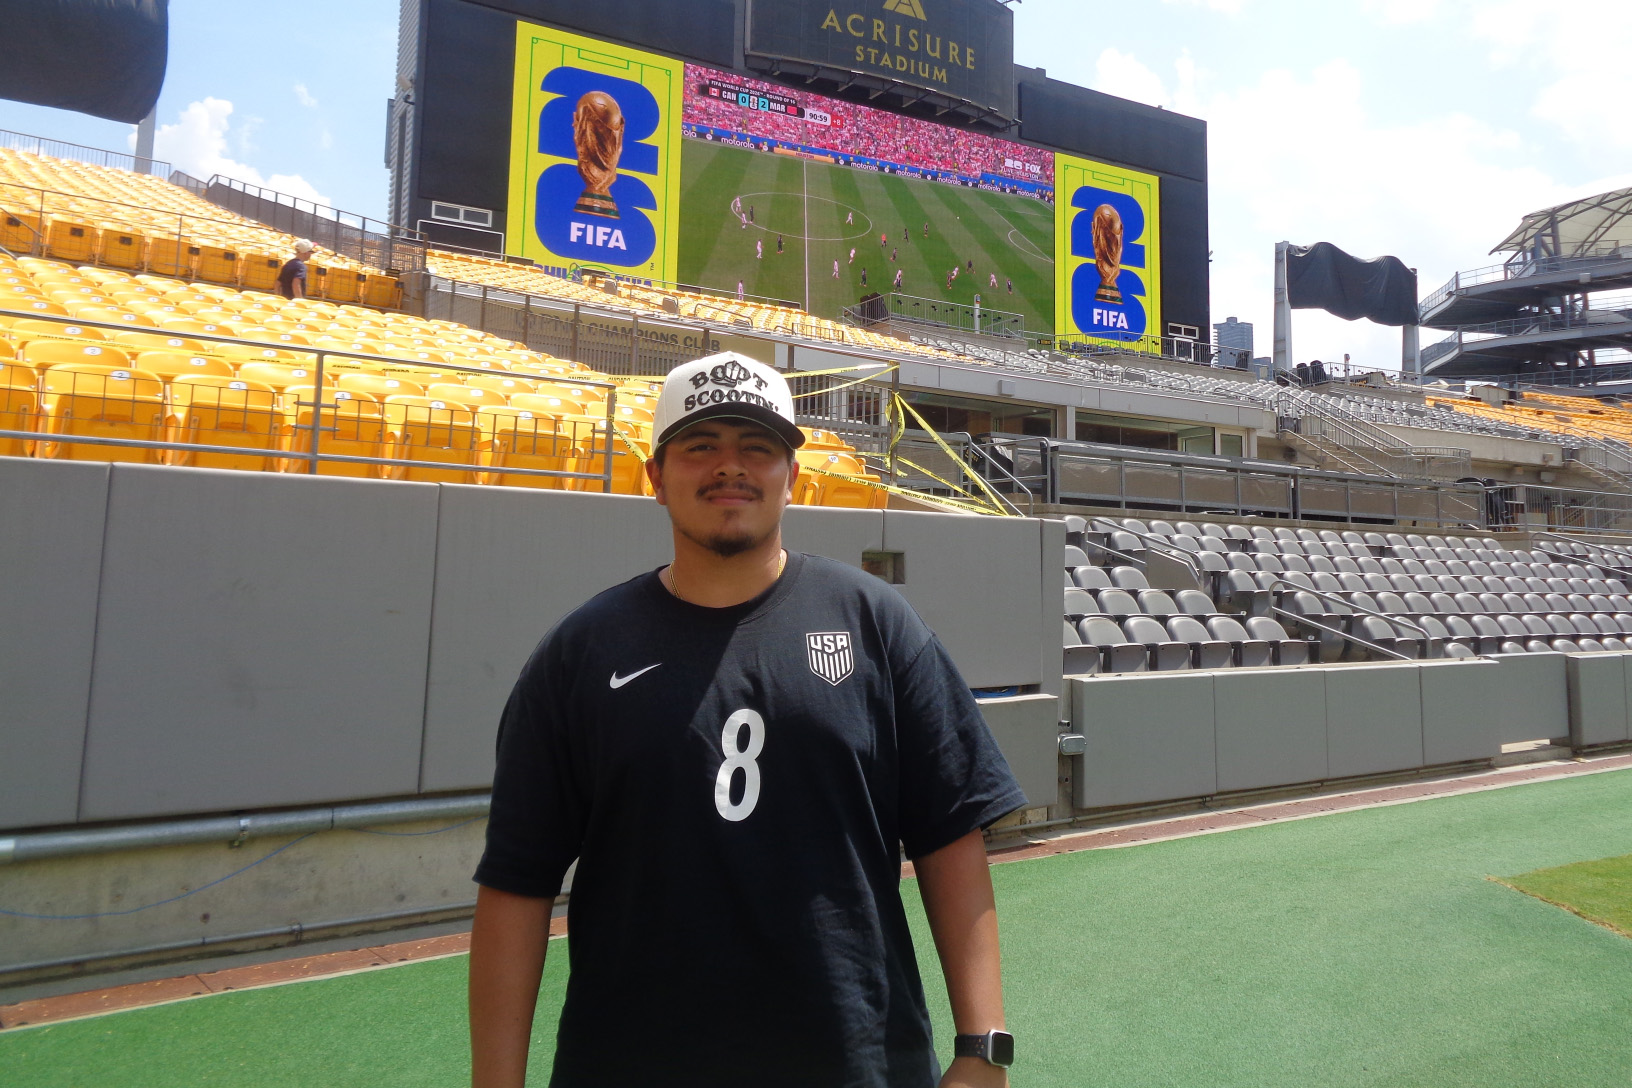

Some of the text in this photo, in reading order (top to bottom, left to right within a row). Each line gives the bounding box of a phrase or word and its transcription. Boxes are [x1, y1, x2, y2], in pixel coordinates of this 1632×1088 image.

[821, 9, 975, 70] ACRISURE
[856, 46, 947, 84] STADIUM
[722, 83, 739, 91] WORLD
[766, 94, 783, 102] ROUND
[722, 91, 737, 101] CAN
[769, 102, 786, 113] MAR
[809, 112, 828, 123] 90:59
[721, 136, 755, 149] motorola
[851, 162, 879, 172] motorola
[896, 169, 922, 179] motorola
[1025, 163, 1041, 174] FOX
[937, 176, 961, 186] motorola
[1017, 190, 1040, 200] motorola
[570, 221, 627, 250] FIFA
[1093, 308, 1128, 329] FIFA
[683, 335, 720, 351] CLB
[810, 635, 848, 653] USA
[714, 708, 766, 822] 8
